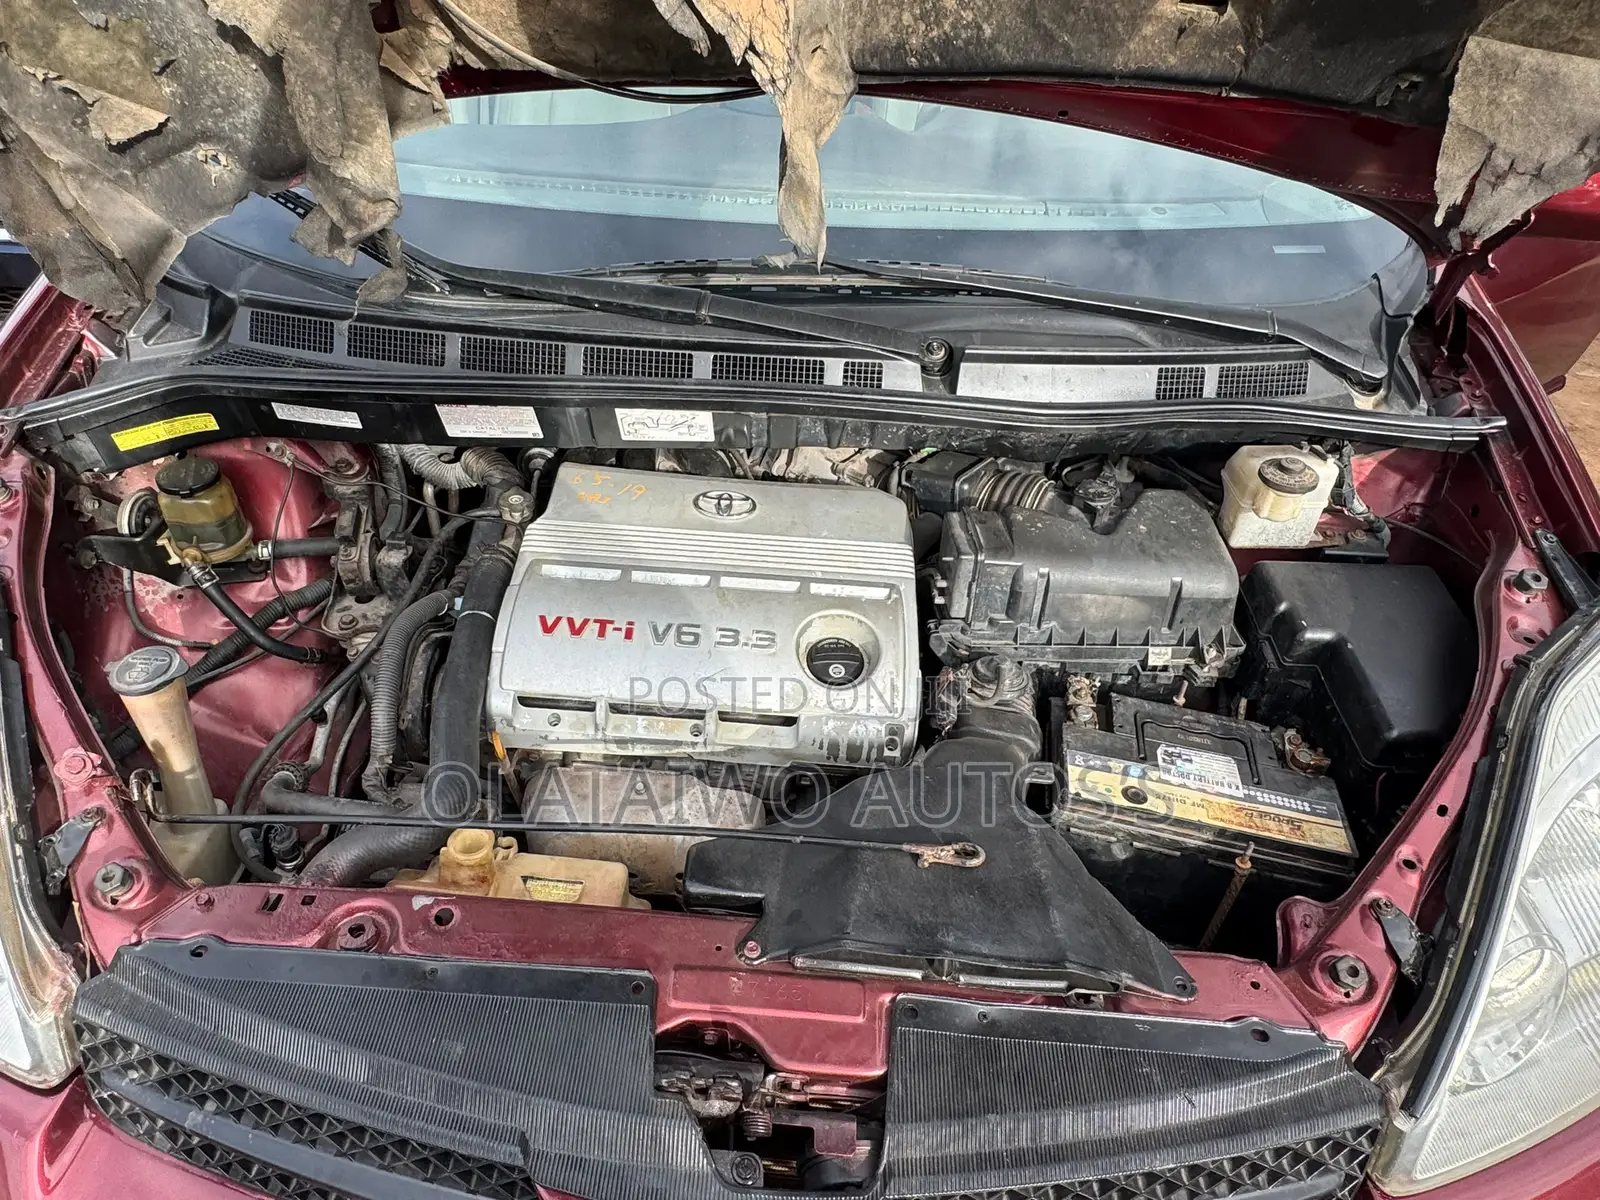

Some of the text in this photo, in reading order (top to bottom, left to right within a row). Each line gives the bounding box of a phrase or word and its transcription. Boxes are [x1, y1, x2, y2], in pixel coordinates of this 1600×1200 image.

[538, 614, 778, 652] VVT-i V6 3.3
